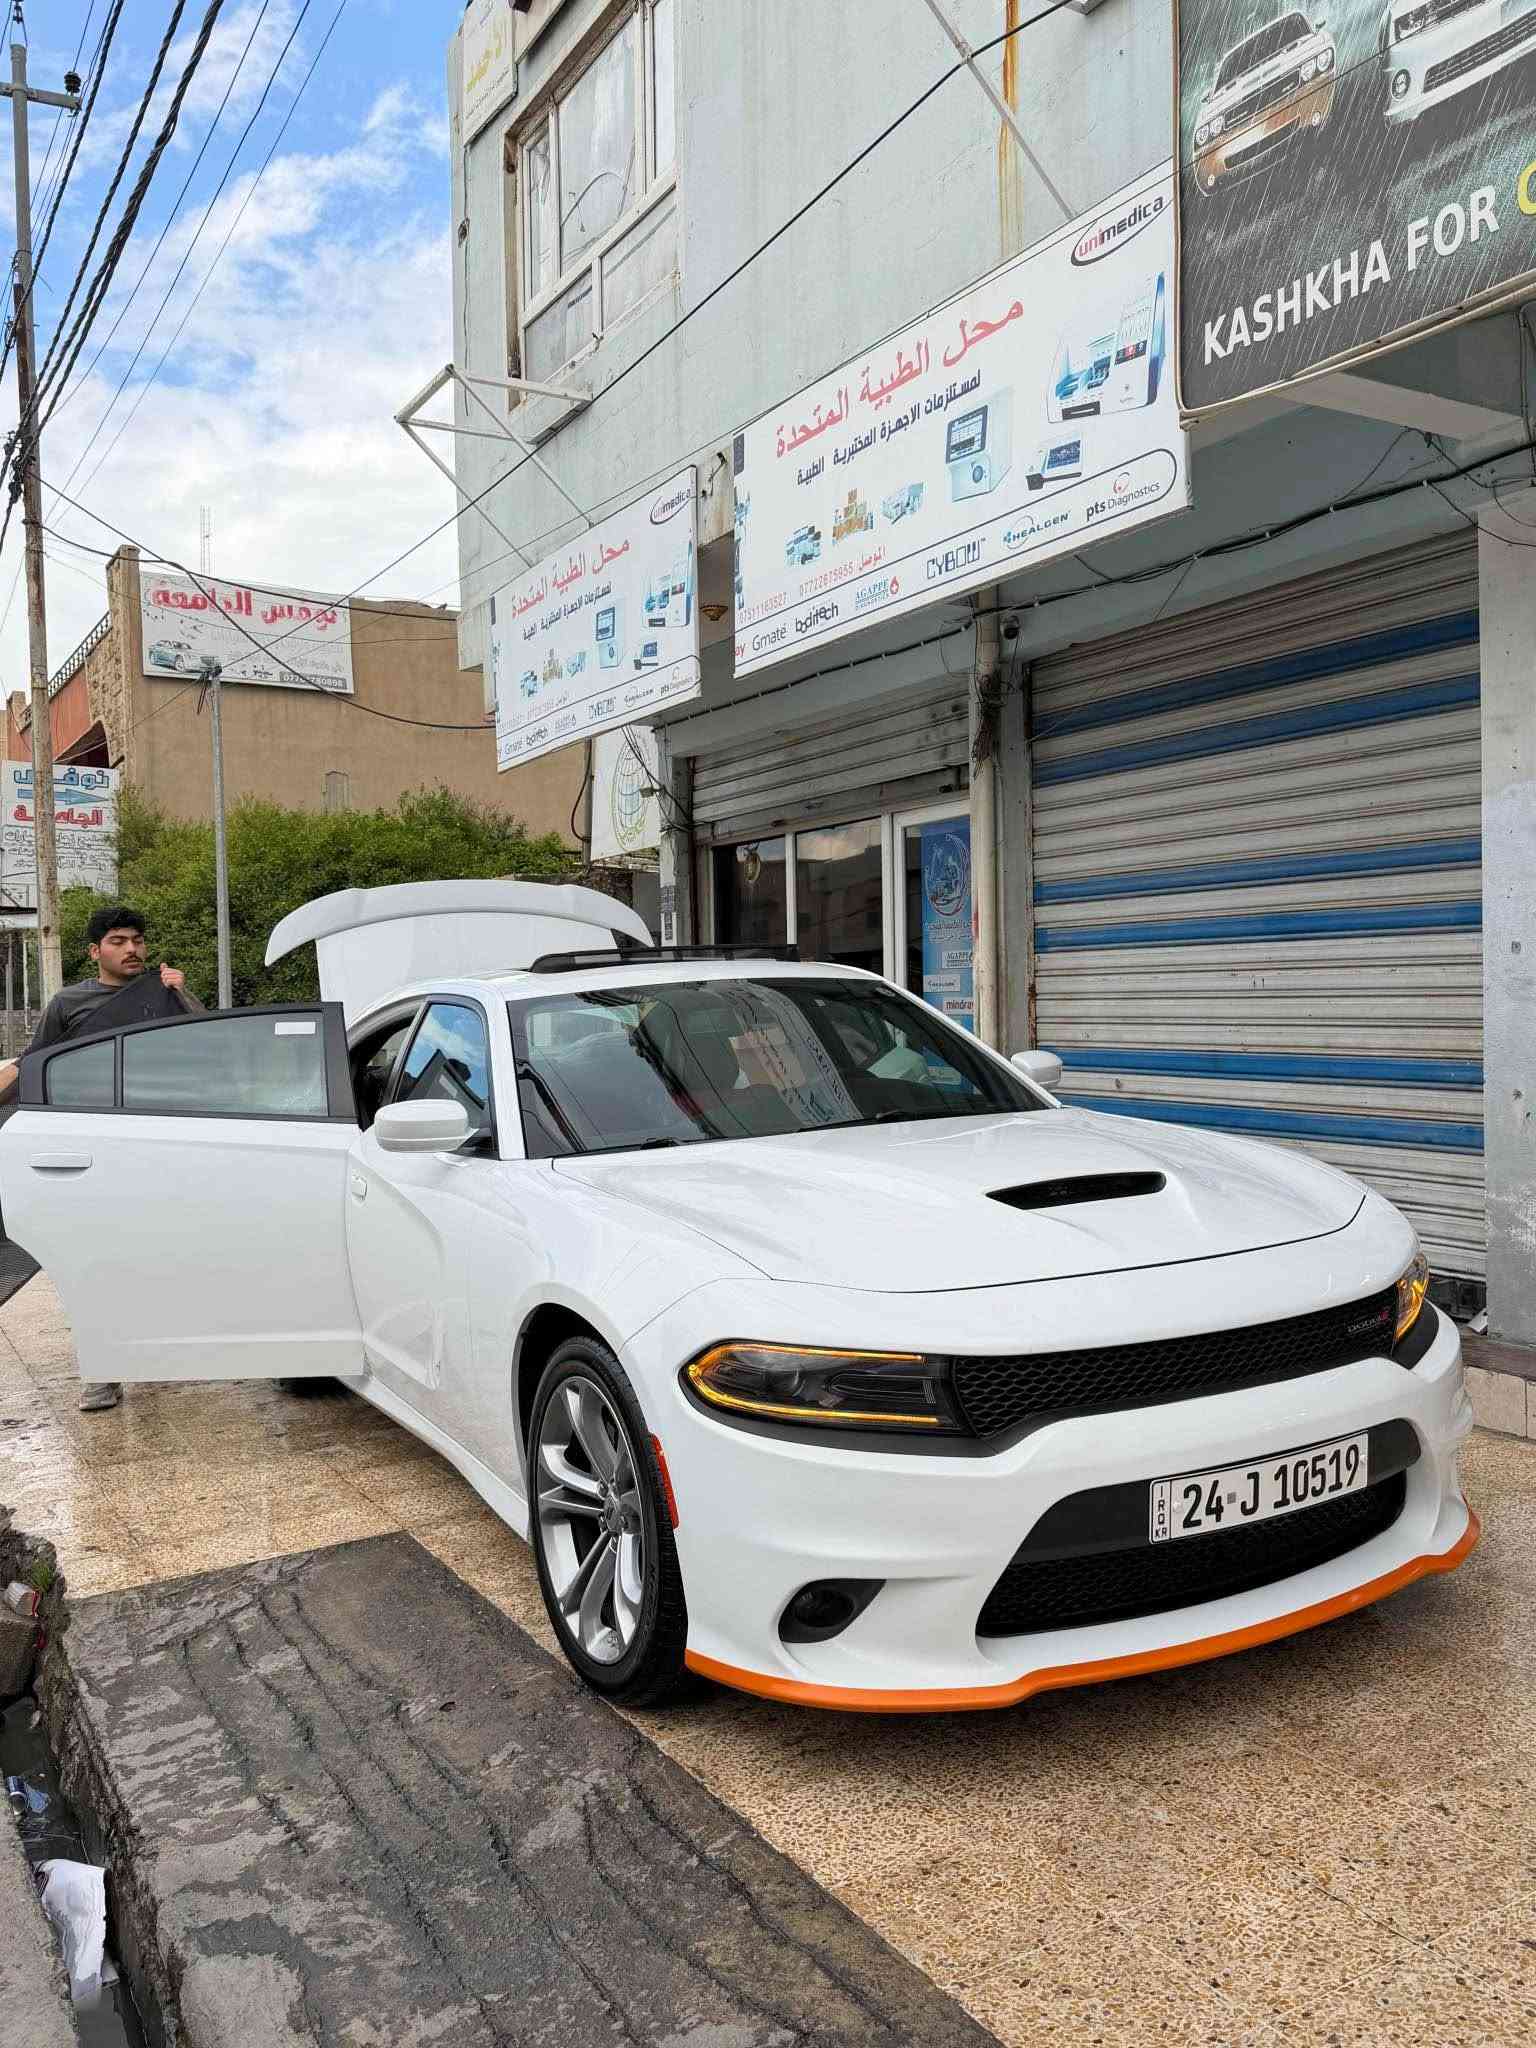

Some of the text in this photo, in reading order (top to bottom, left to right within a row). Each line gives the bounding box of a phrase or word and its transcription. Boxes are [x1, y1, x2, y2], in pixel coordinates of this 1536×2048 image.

[1078, 196, 1164, 257] unimedica
[1203, 239, 1391, 365] KASHKHA
[1407, 185, 1500, 272] FOR
[776, 300, 1024, 459] محل الطبية المتحدة
[797, 369, 981, 486] لمستلزمات الاجهزة المختبرية الطبية
[552, 552, 587, 595] الطبية
[592, 539, 630, 574] محل
[752, 626, 787, 651] Gmate
[796, 602, 839, 633] boditech
[927, 541, 981, 579] CYBOW
[1086, 500, 1107, 521] pts
[1108, 481, 1160, 509] Diagnostics
[14, 805, 103, 828] الجامة
[1182, 1444, 1360, 1529] 24 J 10519
[1155, 1527, 1168, 1538] KR
